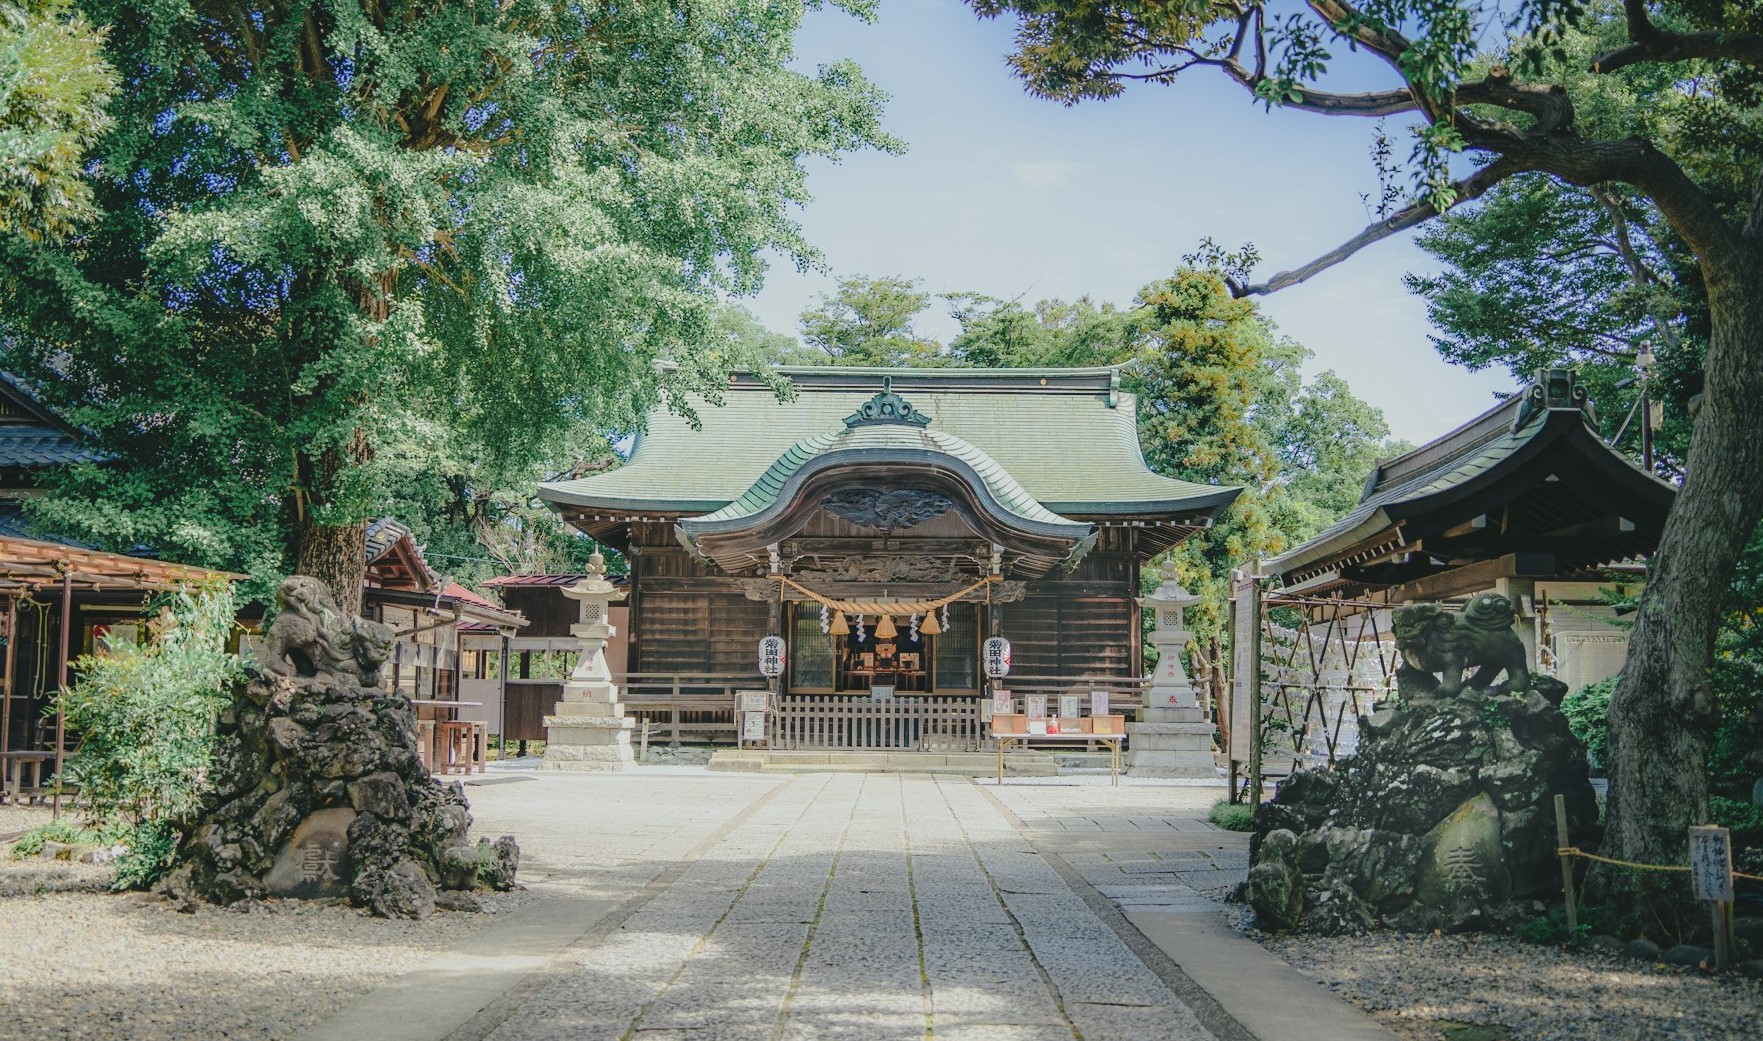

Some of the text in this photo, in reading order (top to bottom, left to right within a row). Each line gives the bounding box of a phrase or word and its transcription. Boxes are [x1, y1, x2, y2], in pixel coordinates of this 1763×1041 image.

[765, 638, 779, 674] 菊田神社
[989, 639, 1002, 675] 菊田神社
